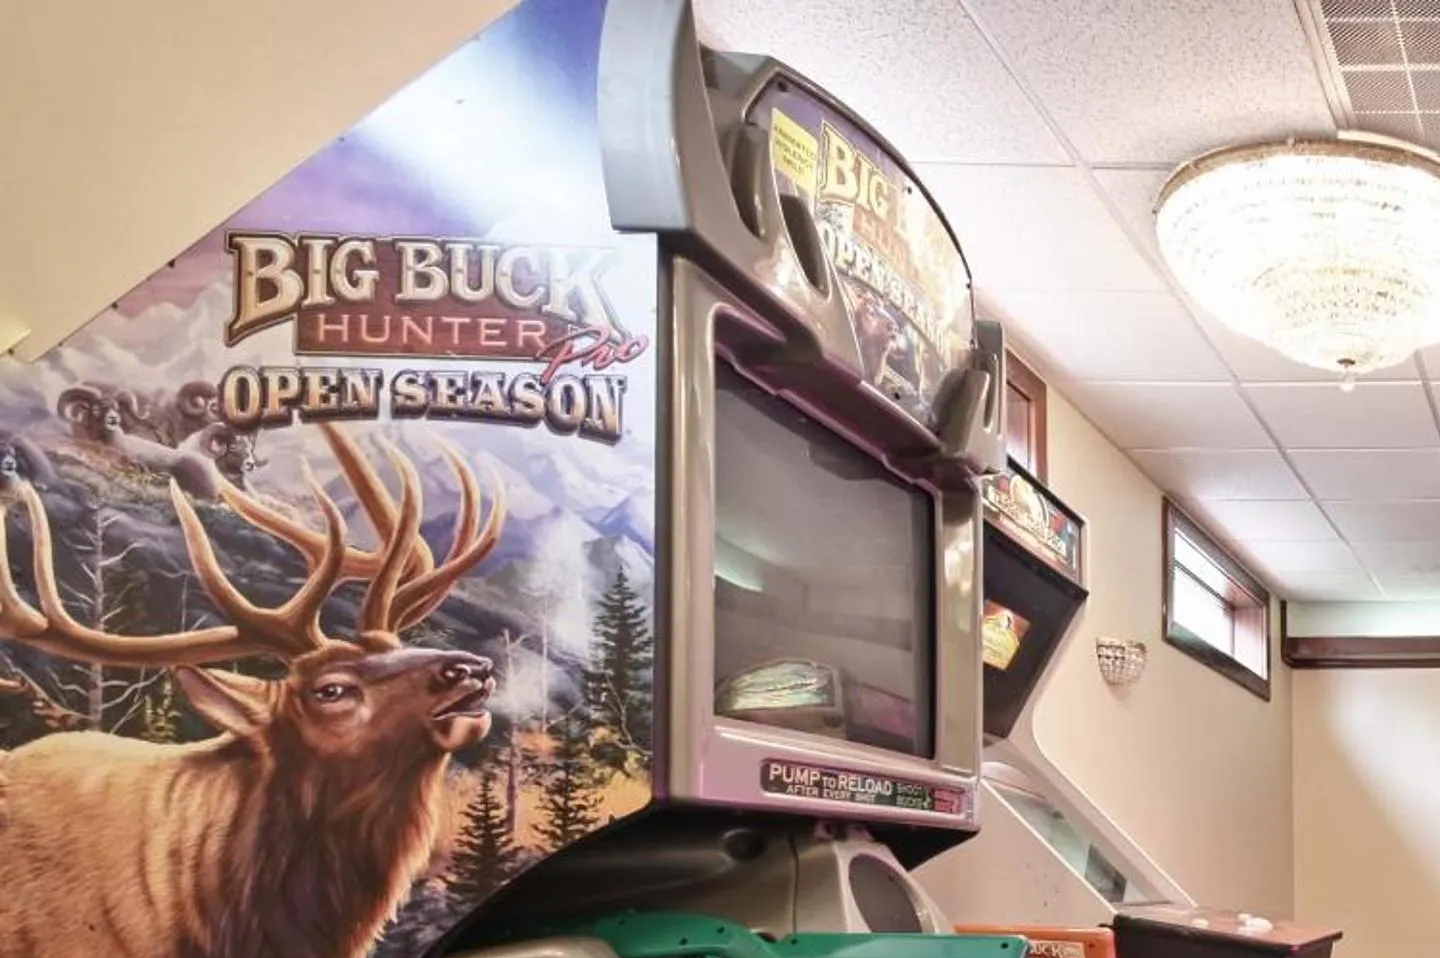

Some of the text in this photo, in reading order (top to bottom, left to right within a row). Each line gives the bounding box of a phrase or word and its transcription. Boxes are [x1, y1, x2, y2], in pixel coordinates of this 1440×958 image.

[820, 122, 892, 222] BIG
[225, 232, 634, 346] BIG BUCK
[317, 313, 648, 384] HUNTER Pro
[220, 366, 626, 446] OPEN SEASON
[769, 763, 821, 786] PUMP
[823, 777, 837, 789] TO
[838, 775, 893, 796] RELOAD
[786, 784, 819, 797] AFTER
[823, 788, 852, 799] EVERY
